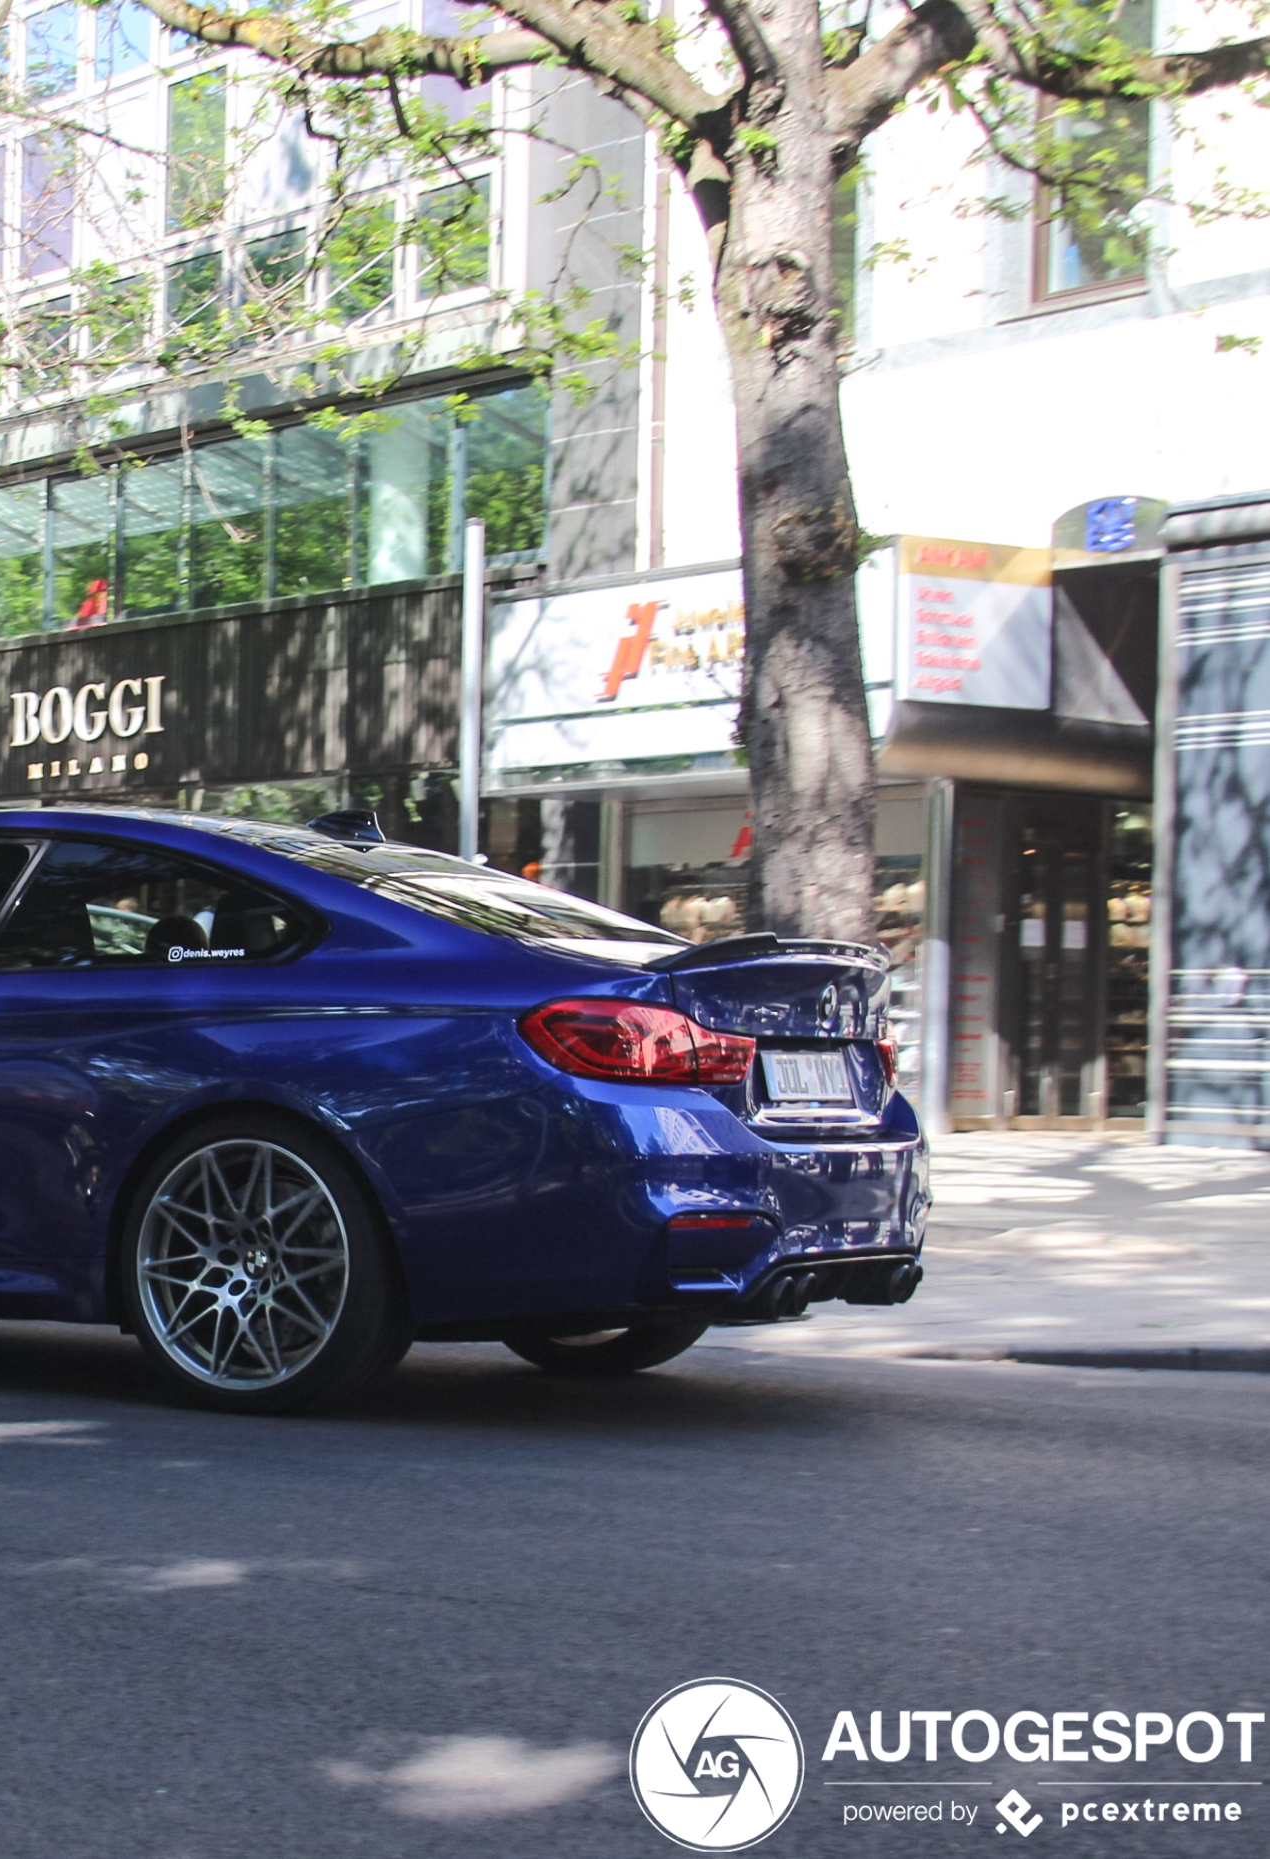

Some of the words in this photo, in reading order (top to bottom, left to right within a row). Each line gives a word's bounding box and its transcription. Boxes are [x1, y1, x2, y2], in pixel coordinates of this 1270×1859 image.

[10, 676, 166, 746] BOGGI
[27, 752, 149, 780] MILANO
[183, 948, 245, 959] denis.weyres
